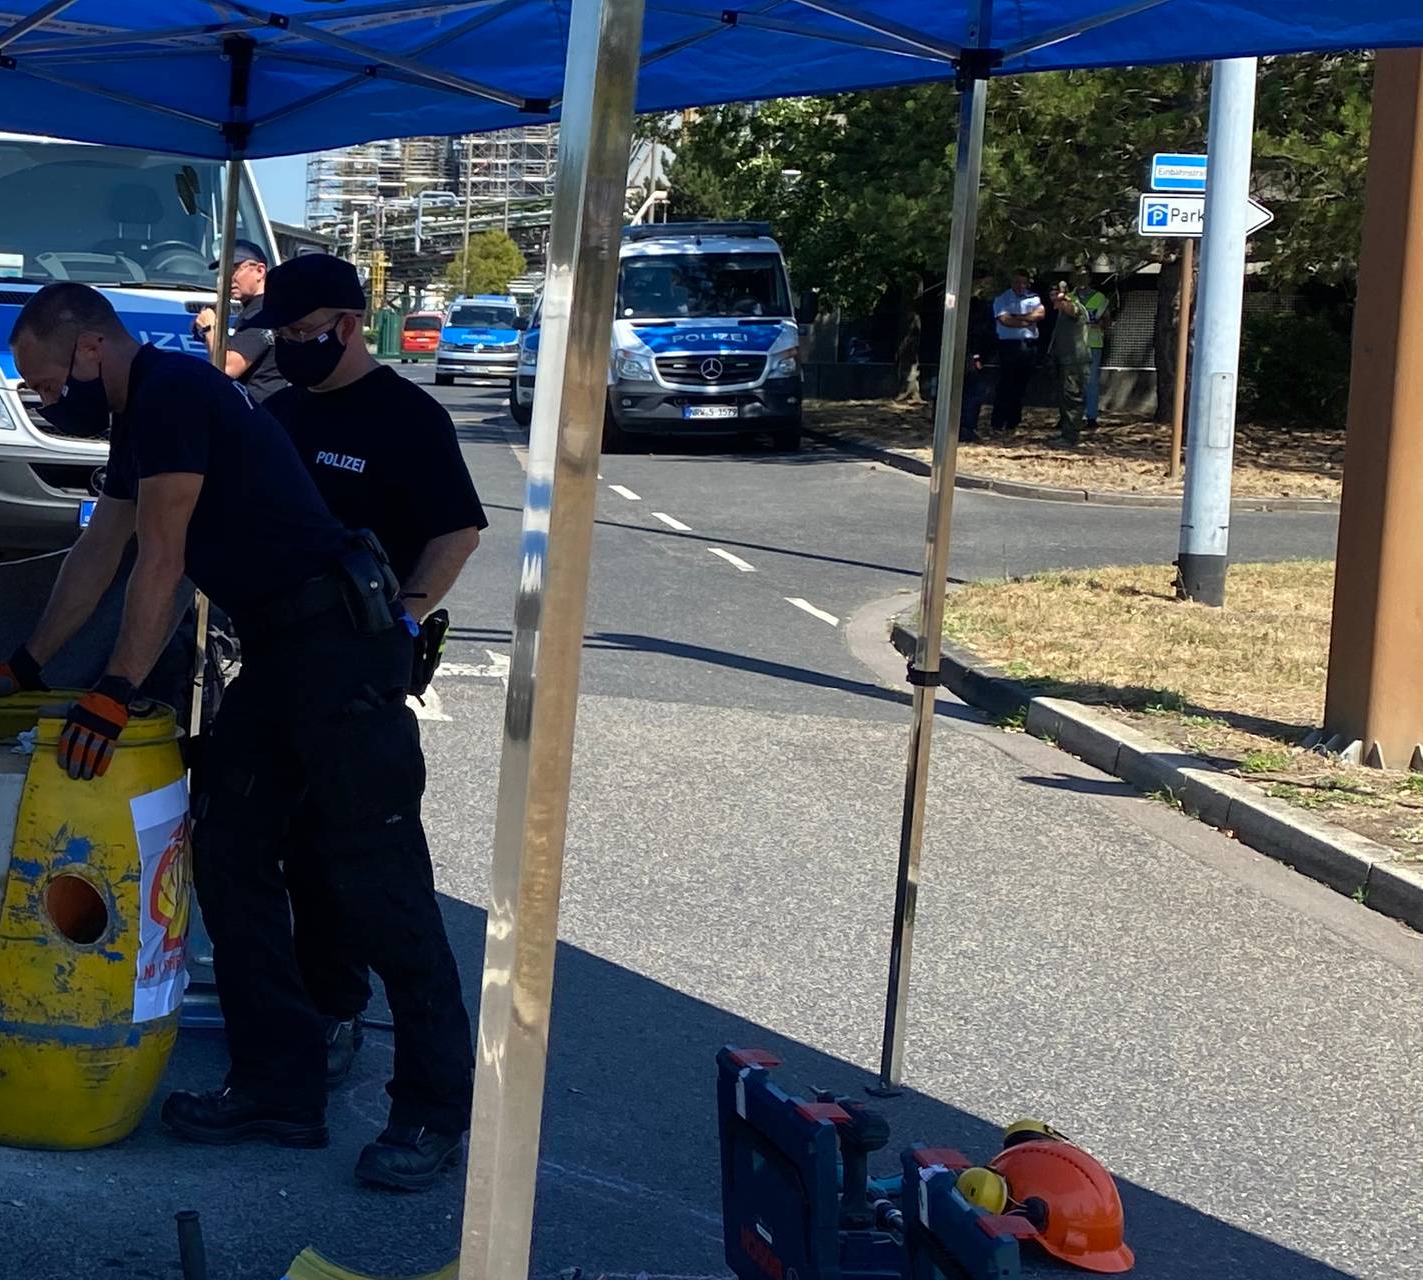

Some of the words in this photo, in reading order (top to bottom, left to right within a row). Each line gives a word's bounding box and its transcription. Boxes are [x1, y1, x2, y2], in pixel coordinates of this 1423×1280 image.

[1158, 167, 1206, 177] Einbahnstra
[1171, 208, 1205, 222] Park
[672, 333, 748, 343] POLIZEI
[316, 451, 366, 473] POLIZEI
